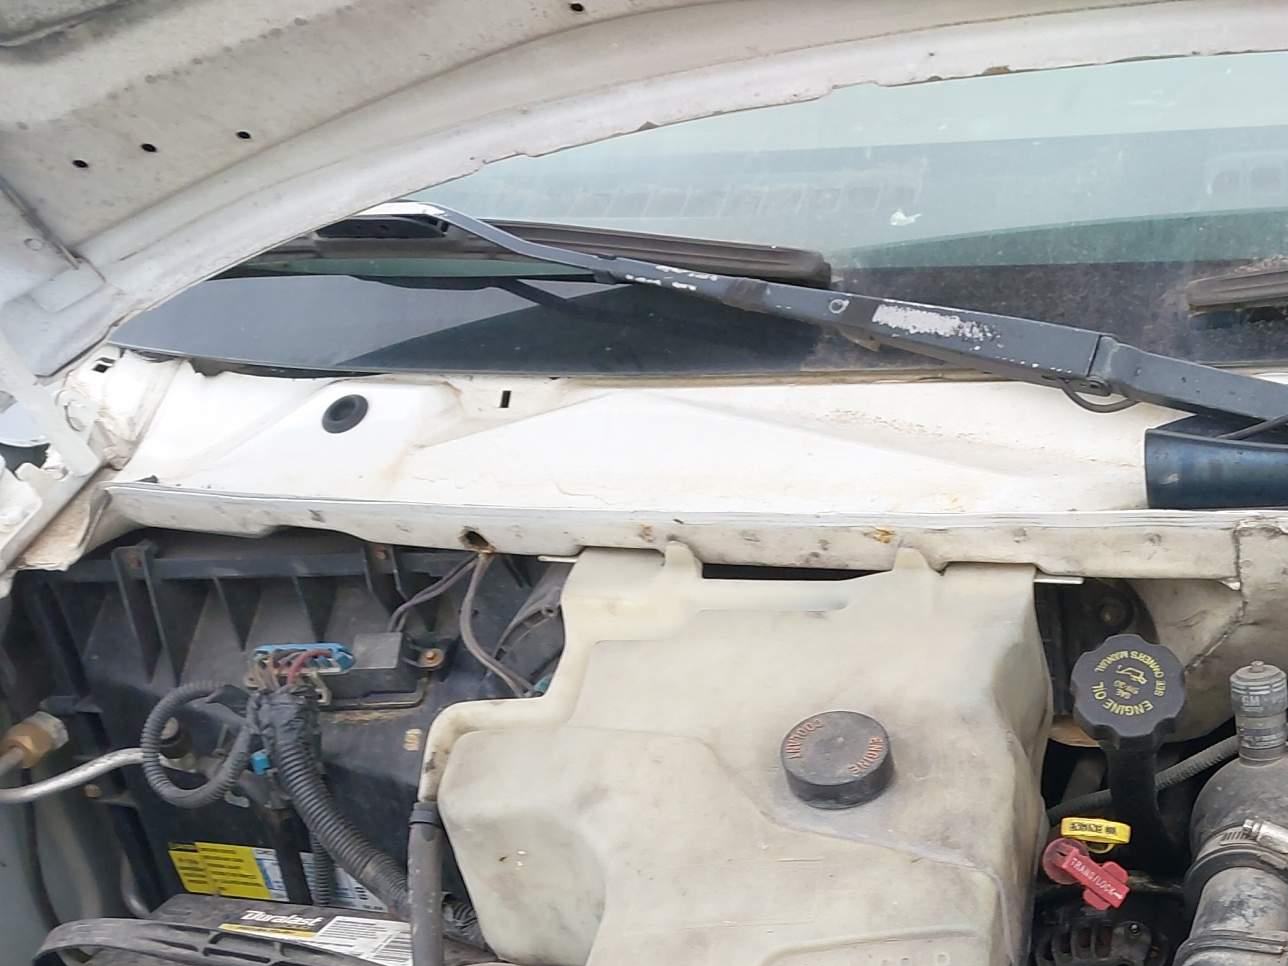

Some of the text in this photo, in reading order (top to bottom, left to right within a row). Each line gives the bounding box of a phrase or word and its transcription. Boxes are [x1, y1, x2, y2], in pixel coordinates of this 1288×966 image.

[1091, 681, 1154, 716] ENGINE OIL
[784, 719, 824, 760] COOLANT
[848, 736, 884, 777] ENGINE
[240, 909, 325, 927] Duralast
